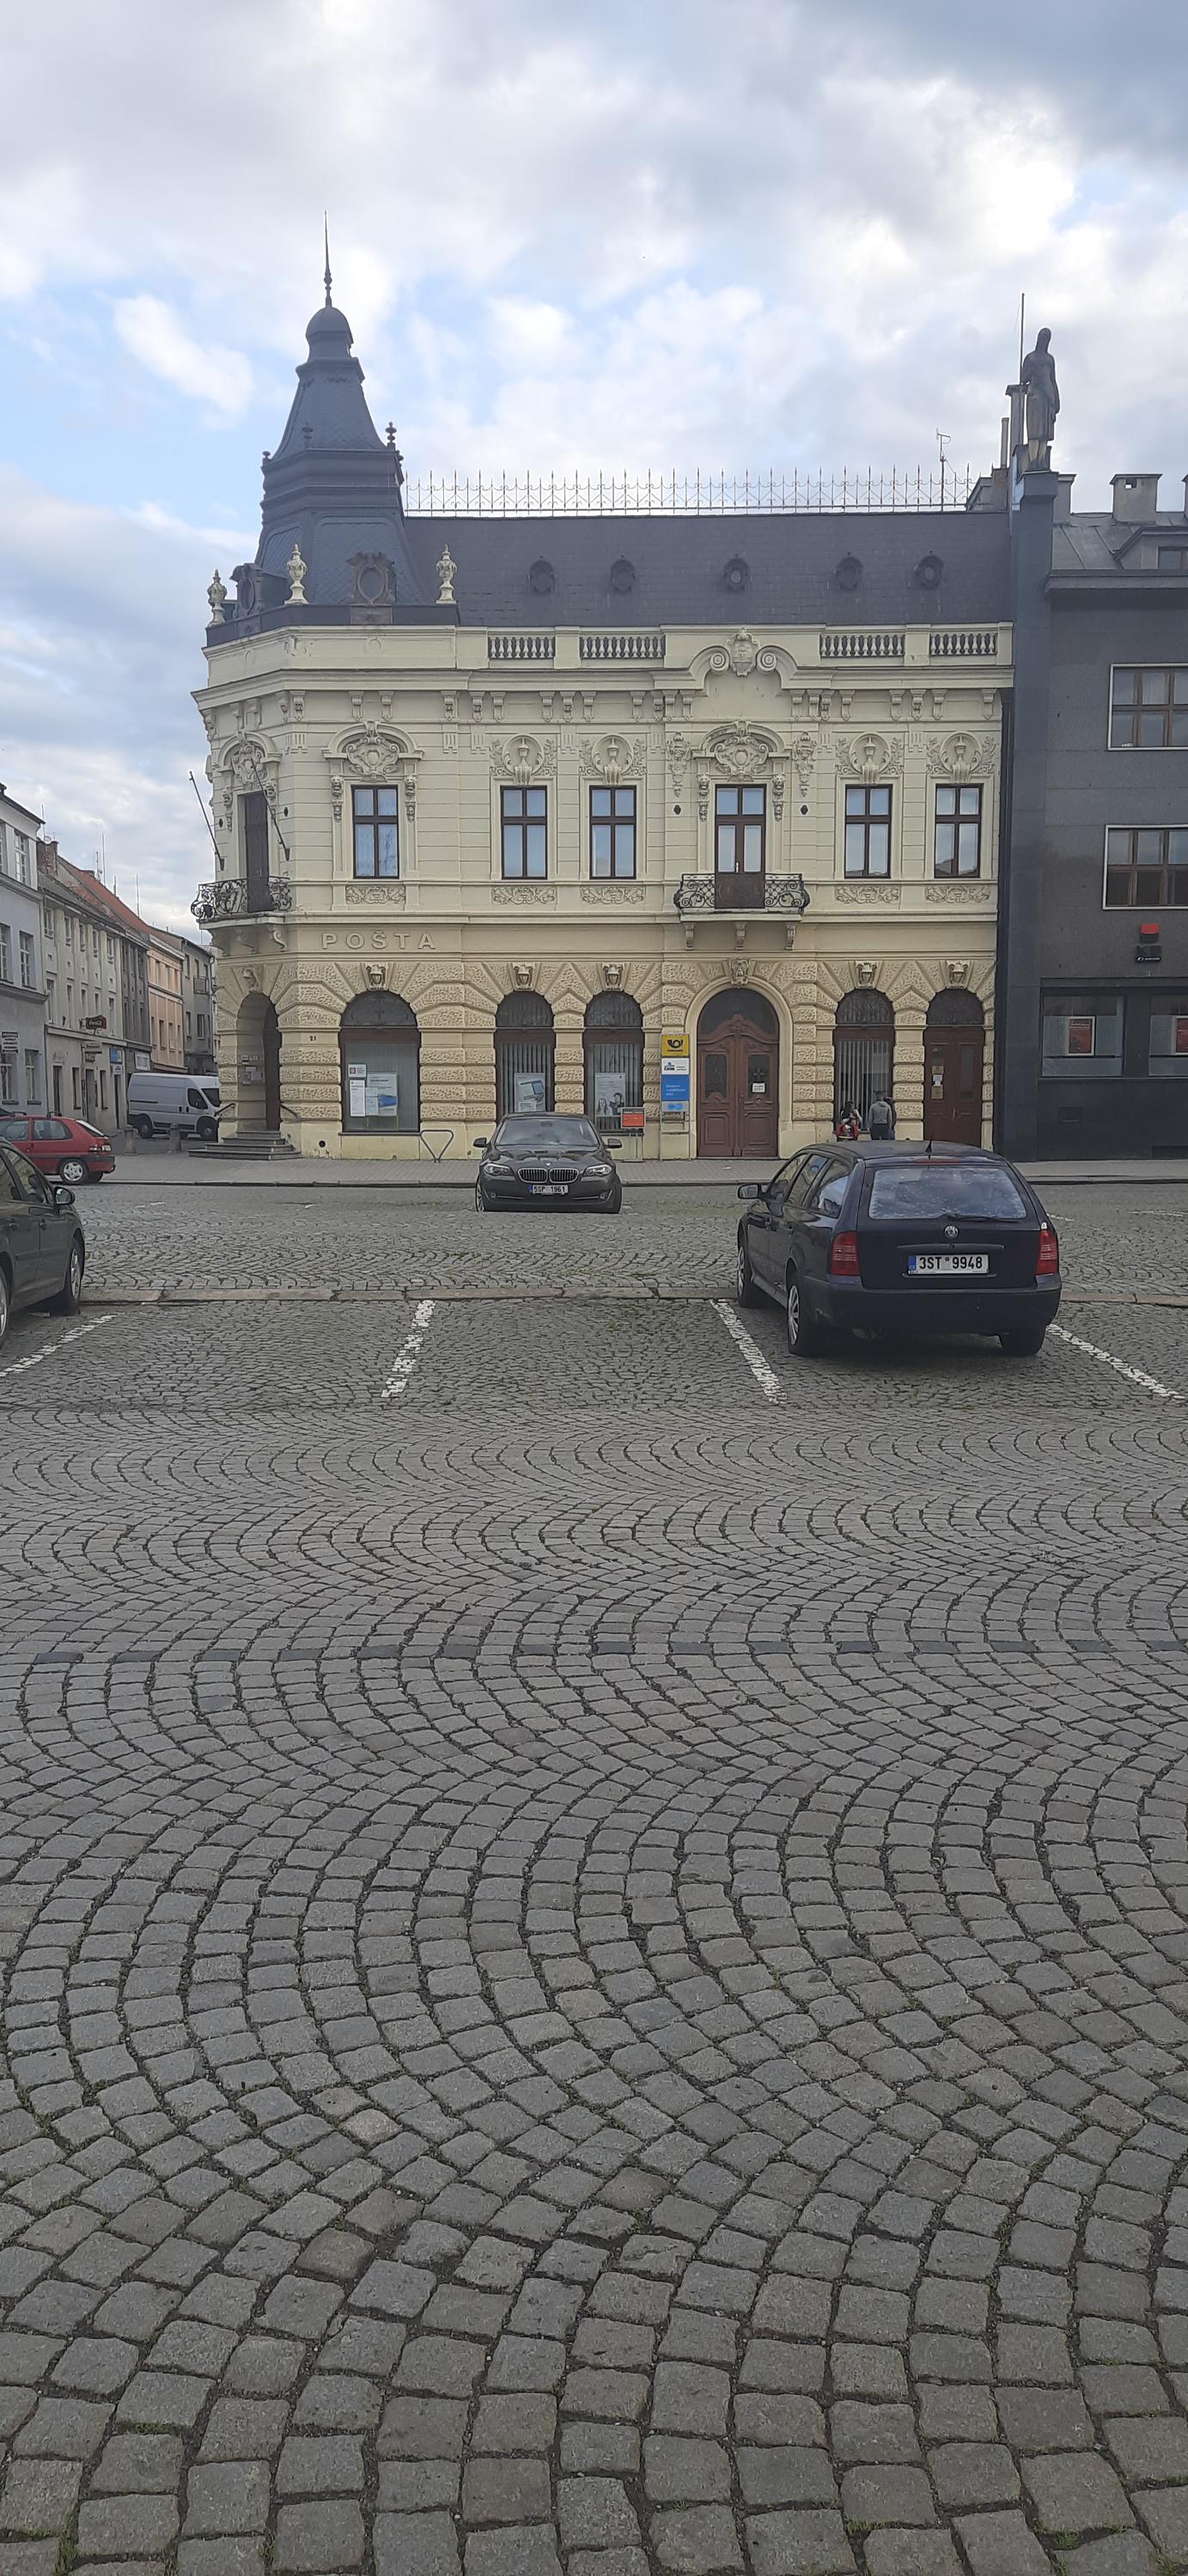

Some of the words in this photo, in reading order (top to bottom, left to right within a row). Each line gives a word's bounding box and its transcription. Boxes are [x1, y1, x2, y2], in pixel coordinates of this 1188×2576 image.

[321, 930, 436, 949] POŠTA
[919, 1256, 941, 1269] 3ST
[952, 1256, 983, 1269] 9948
